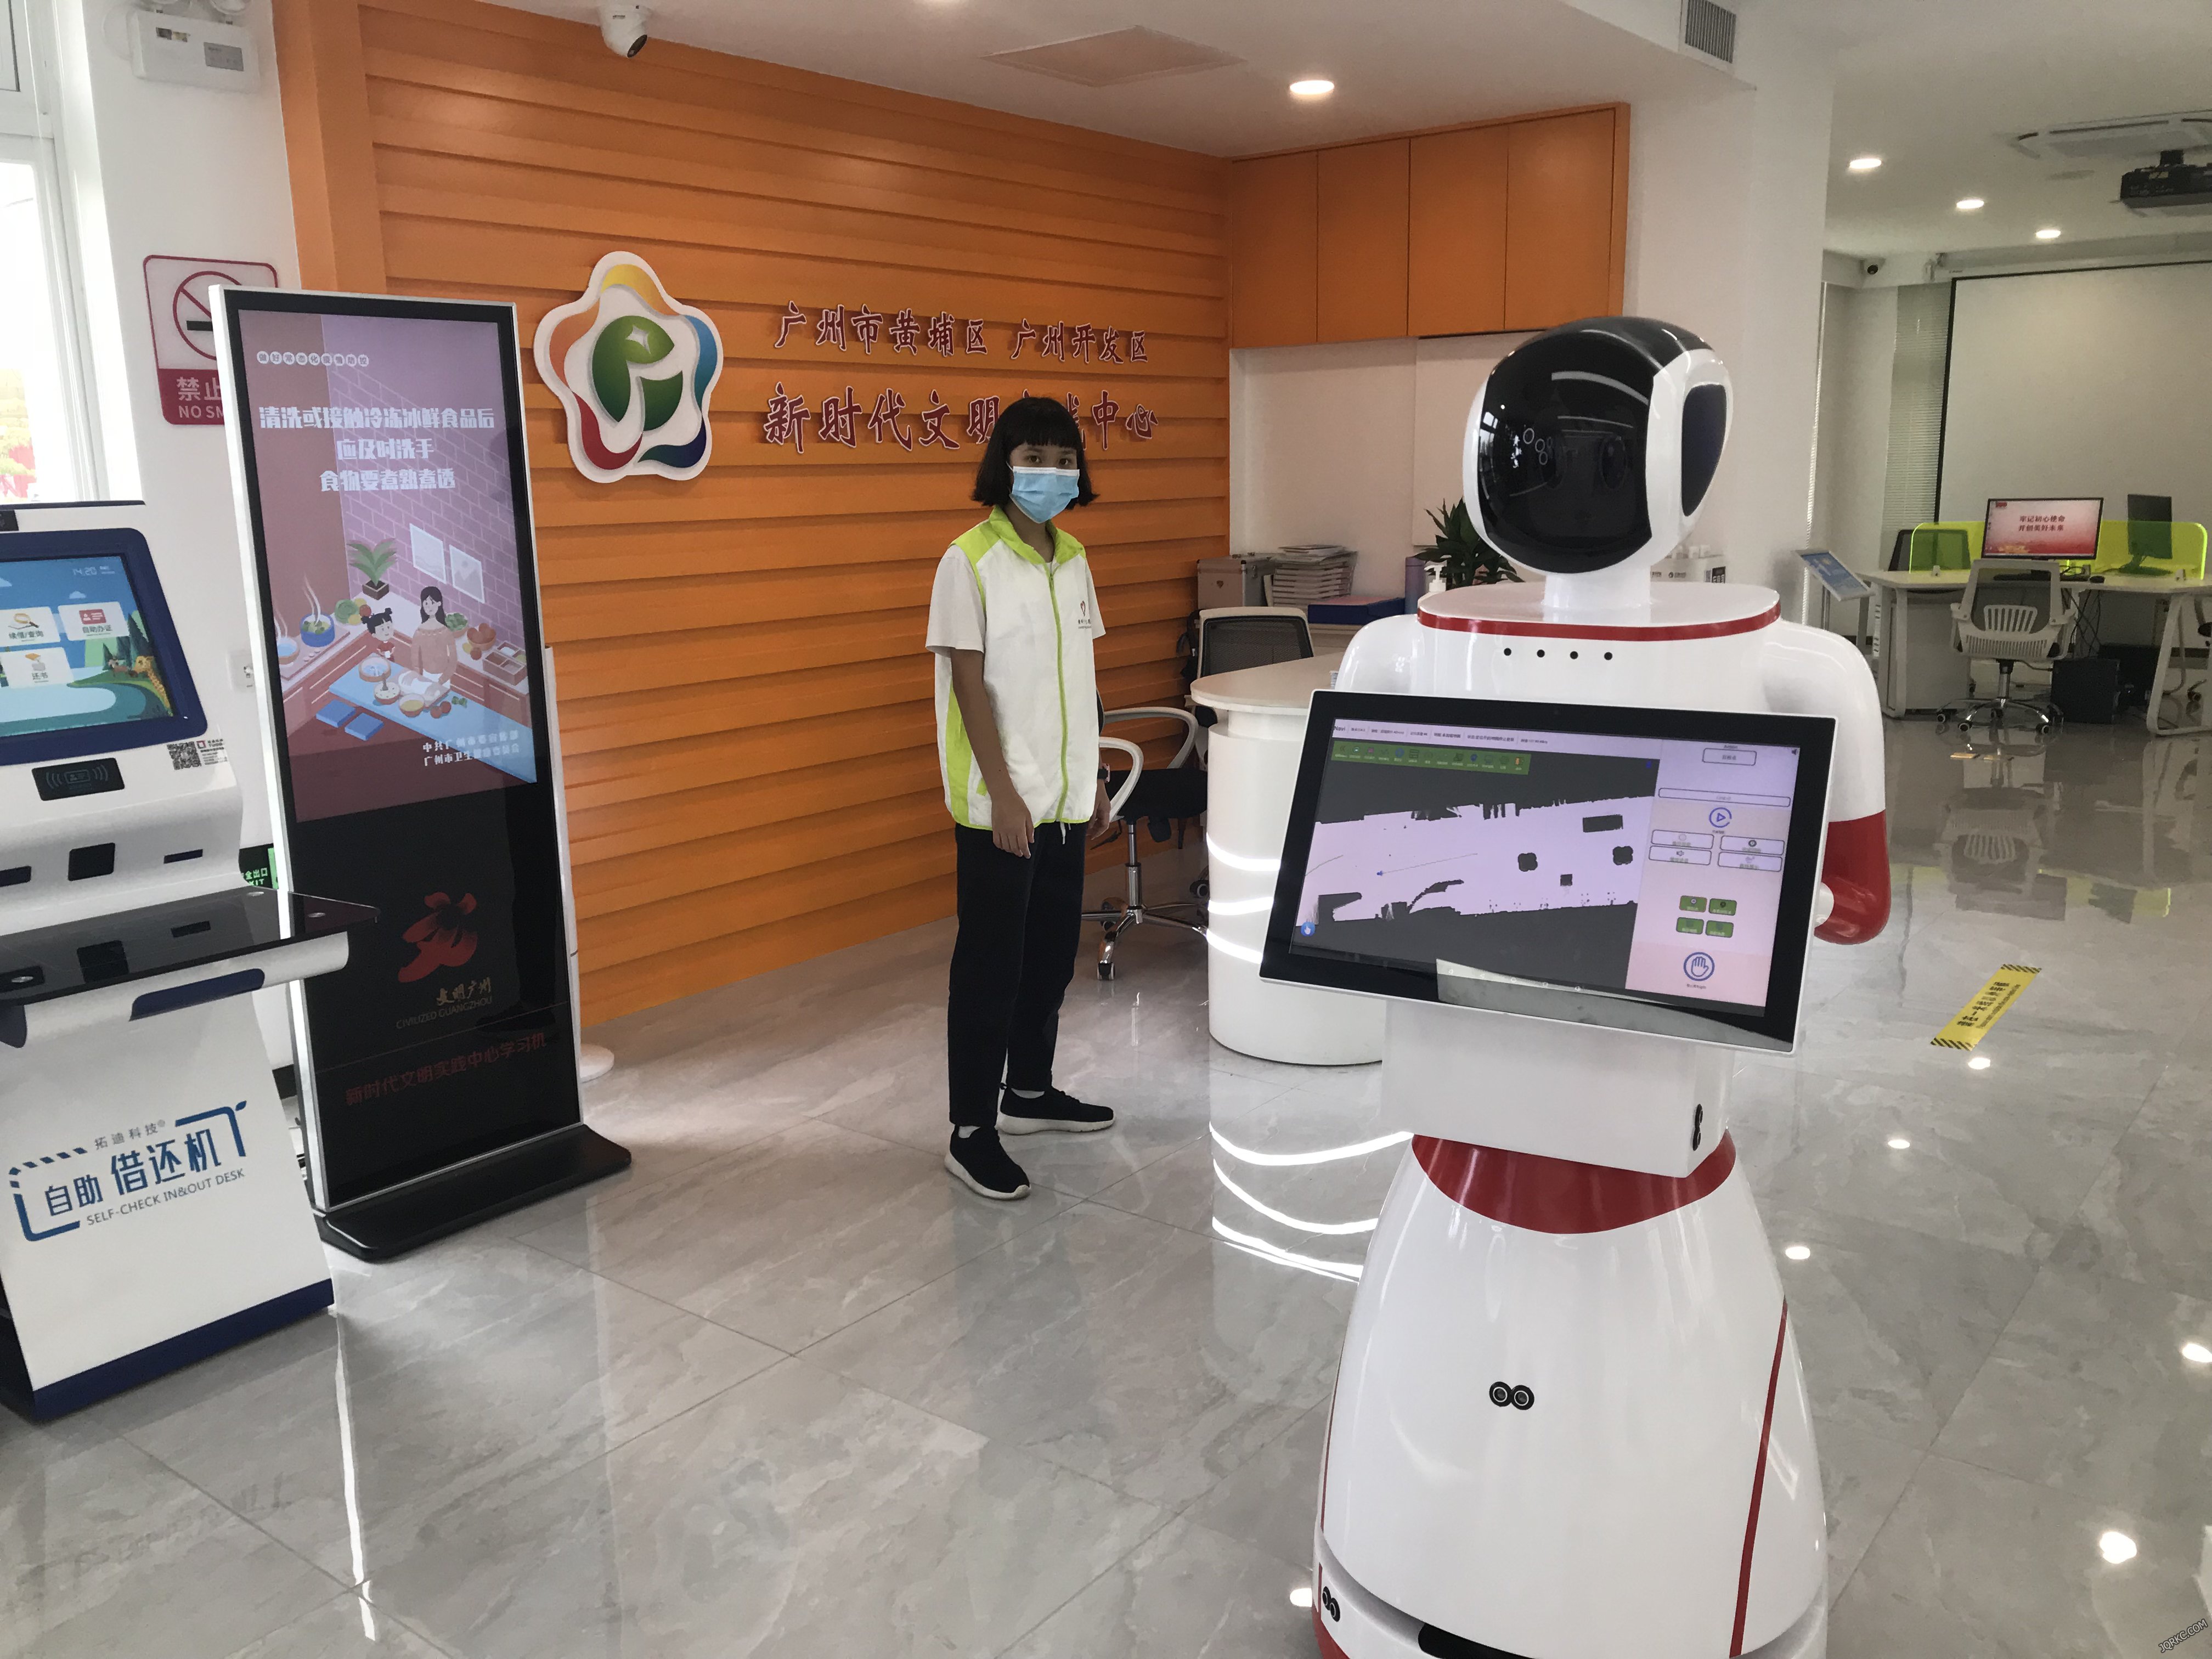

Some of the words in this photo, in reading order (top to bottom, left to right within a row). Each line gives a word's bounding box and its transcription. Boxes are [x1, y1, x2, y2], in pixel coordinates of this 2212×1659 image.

[775, 301, 988, 357] 广州市黄埔区
[1011, 318, 1149, 364] 广州开发区
[178, 405, 201, 418] NO
[259, 407, 495, 429] 清洗或接触冷冻冰鲜食品后
[764, 382, 1159, 454] 新时代文明中心
[336, 438, 434, 460] 应及时洗手
[319, 468, 455, 492] 食物要煮熟煮透
[396, 1011, 437, 1029] CIVILIZED
[438, 996, 492, 1018] GUANGZHOU
[346, 1032, 546, 1106] 新时代文明实践中心学习机
[87, 1194, 160, 1226] SELF-CHECK
[163, 1178, 212, 1202] IN&OUT
[215, 1168, 246, 1186] DESK
